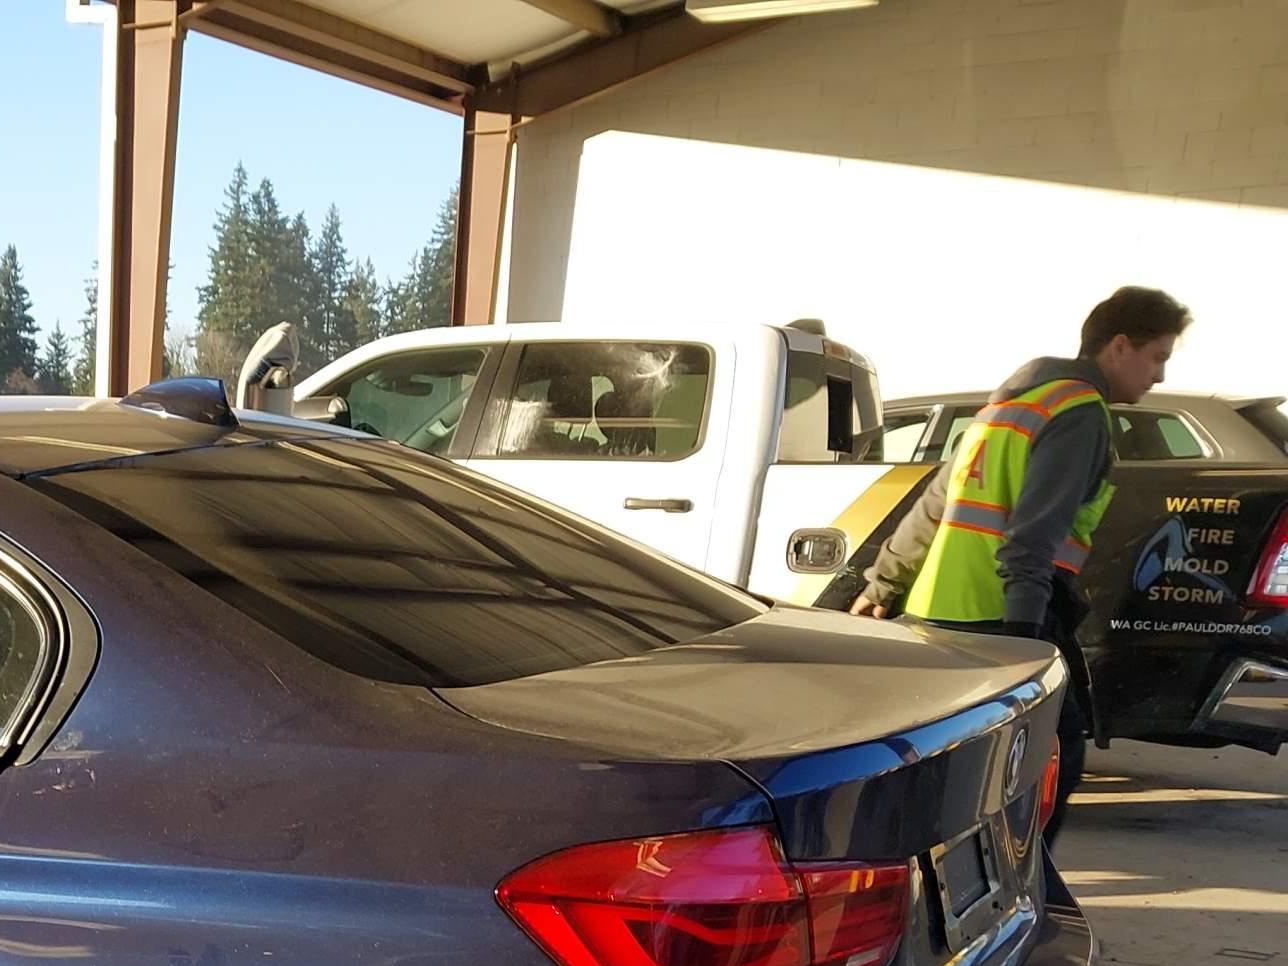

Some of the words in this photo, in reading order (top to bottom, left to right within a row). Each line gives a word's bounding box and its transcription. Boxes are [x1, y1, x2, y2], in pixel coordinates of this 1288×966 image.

[1166, 497, 1241, 514] WATER
[1187, 528, 1235, 545] FIRE
[1164, 557, 1229, 575] MOLD
[1148, 586, 1224, 605] STORM
[1110, 619, 1131, 630] WA
[1133, 620, 1152, 631] GC
